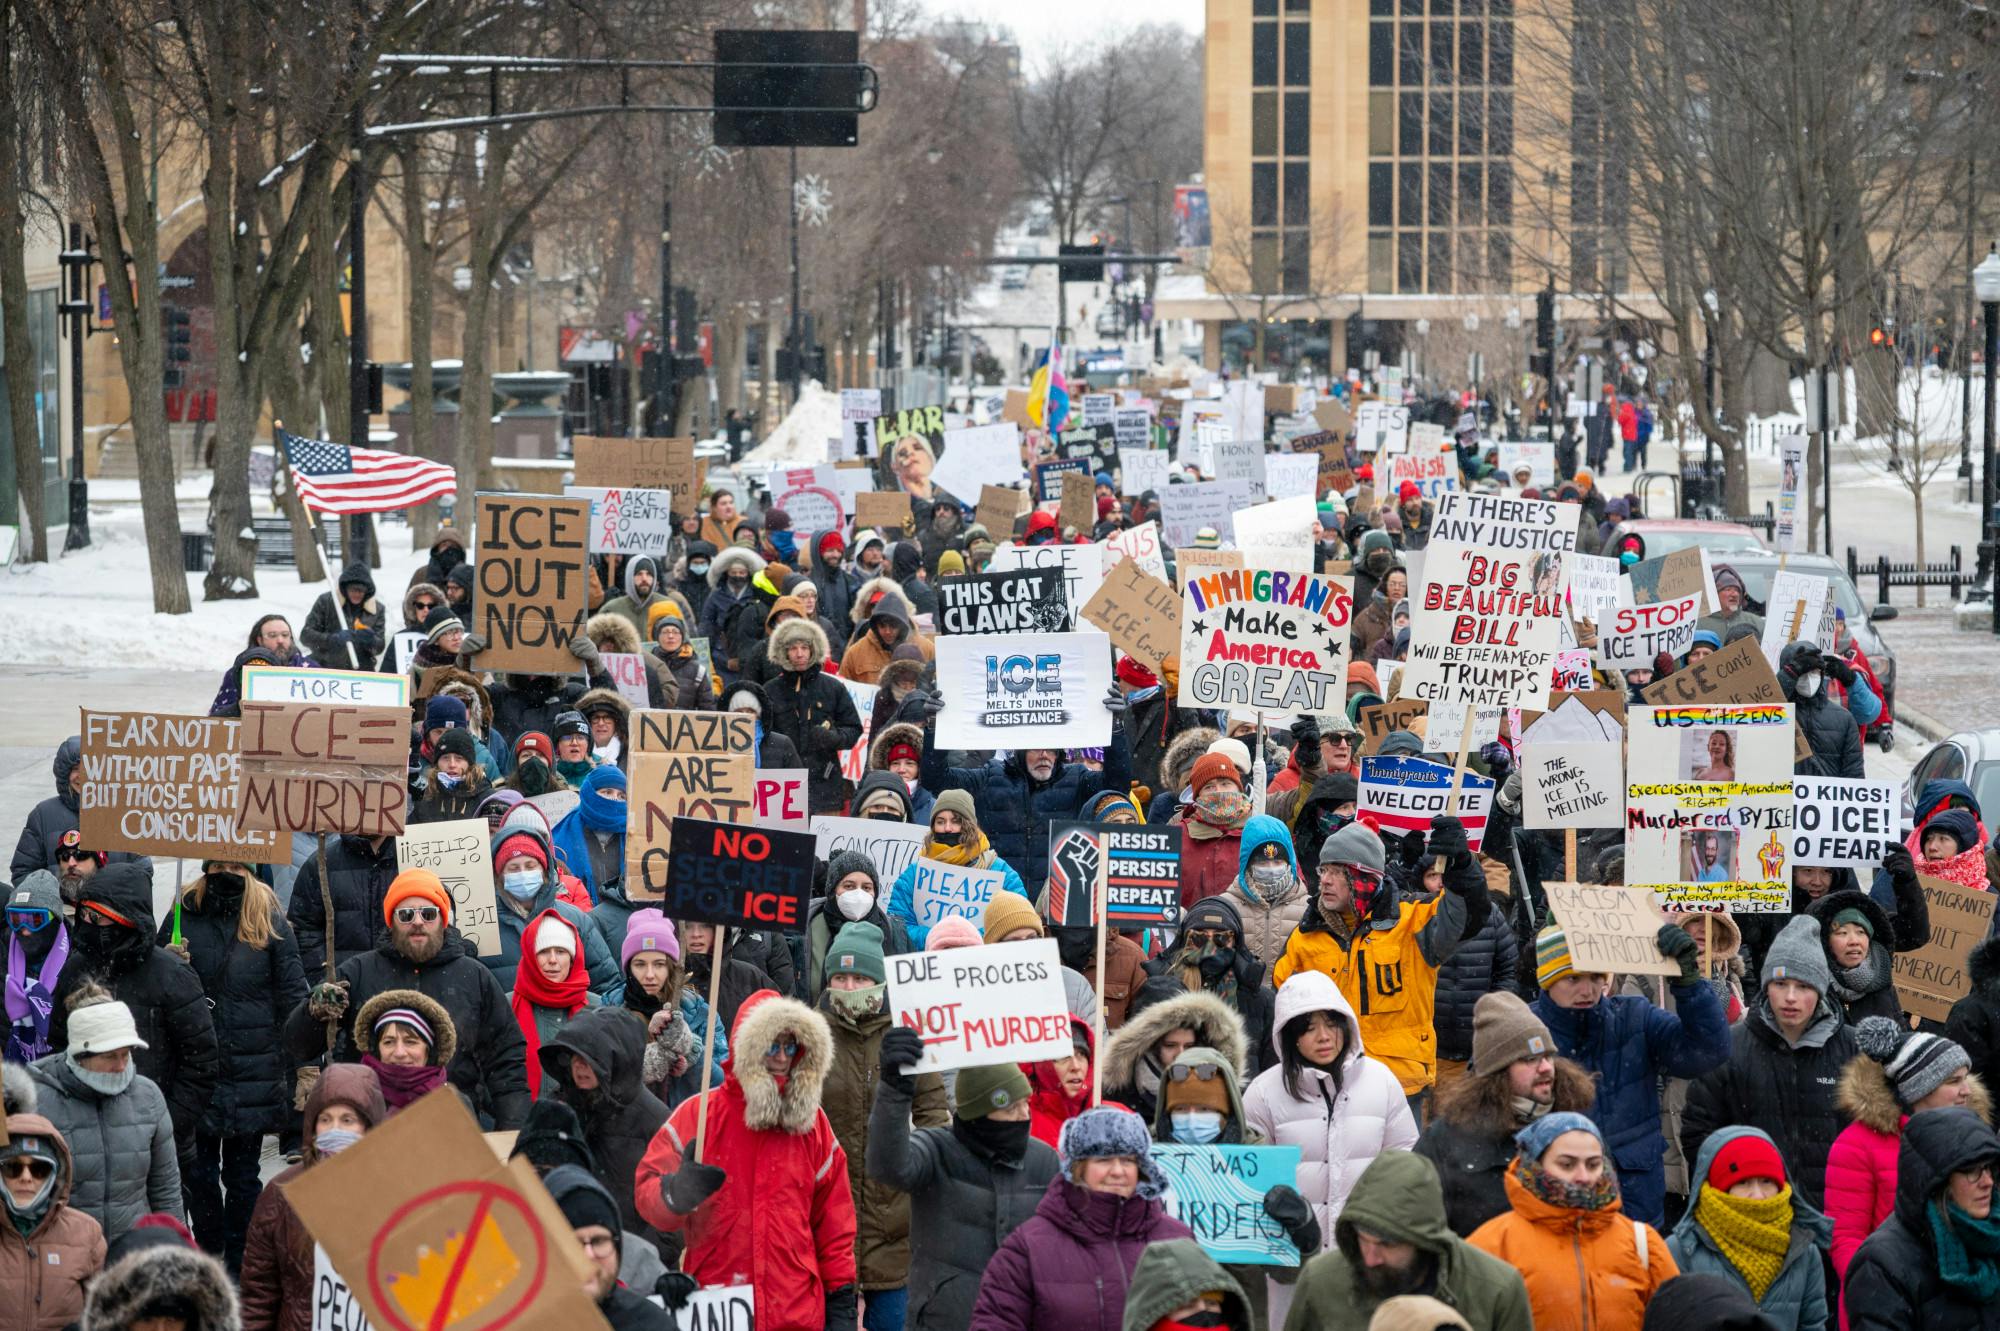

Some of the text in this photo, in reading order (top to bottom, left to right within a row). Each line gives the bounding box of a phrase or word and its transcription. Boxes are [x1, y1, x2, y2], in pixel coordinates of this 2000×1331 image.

[876, 406, 945, 450] LIAR
[635, 440, 686, 465] ICE
[1128, 455, 1166, 471] FUCK
[1221, 446, 1255, 457] HONK
[603, 489, 657, 505] MAKE
[604, 503, 668, 519] AGENTS
[1438, 494, 1557, 526] IF THERE'S
[482, 502, 583, 550] ICE
[603, 517, 631, 532] GO
[1432, 519, 1577, 553] ANY JUSTICE
[1011, 548, 1078, 571] ICE
[1181, 551, 1236, 564] RIGHTS
[479, 558, 581, 600] OUT
[942, 576, 1043, 607] THIS CAT
[1124, 562, 1145, 593] I
[1187, 568, 1354, 628] IMMIGRANTS
[485, 602, 585, 650] NOW
[943, 600, 1036, 633] CLAWS
[1094, 597, 1142, 642] ICE
[1224, 606, 1299, 641] Make
[1615, 599, 1695, 635] STOP
[1206, 628, 1323, 671] America
[1603, 634, 1636, 660] ICE
[1640, 619, 1697, 658] TERROR
[1443, 646, 1464, 661] BE
[1467, 648, 1490, 662] THE
[1529, 652, 1553, 666] OF
[290, 679, 364, 700] MORE
[985, 653, 1062, 698] ICE
[1191, 661, 1338, 711] GREAT
[1650, 664, 1719, 705] ICE
[985, 711, 1063, 726] RESISTANCE
[986, 698, 1063, 710] MELTS UNDER
[1654, 709, 1695, 728] US
[86, 713, 160, 749] FEAR
[163, 717, 219, 748] NOT
[640, 713, 753, 752] NAZIS
[82, 753, 184, 783] WITHOUT
[661, 756, 733, 795] ARE
[1367, 762, 1439, 785] Immigrants
[1538, 766, 1585, 789] WRONG
[1543, 757, 1567, 772] THE
[82, 783, 121, 811] BUT
[124, 783, 193, 810] THOSE
[1366, 789, 1482, 811] WELCOME
[1544, 778, 1590, 804] ICE IS
[1547, 791, 1609, 820] MELTING
[1682, 797, 1728, 809] RIGHT
[1817, 784, 1891, 804] KINGS!
[237, 775, 406, 837] MURDER
[1764, 807, 1792, 830] ICE
[1832, 804, 1891, 835] ICE!
[712, 827, 772, 862] NO
[1108, 832, 1170, 851] RESIST.
[414, 852, 481, 868] OF OUR
[673, 850, 806, 895] SECRET
[1108, 859, 1179, 879] PERSIST.
[917, 867, 997, 903] PLEASE
[1107, 887, 1177, 906] REPEAT.
[1553, 886, 1638, 911] RACISM
[464, 905, 497, 927] ICE
[672, 882, 798, 925] POLICE
[923, 899, 979, 921] STOP
[1561, 909, 1635, 932] IS NOT
[895, 955, 1048, 989] DUE PROCESS
[1891, 954, 1961, 990] AMERICA
[901, 1002, 1073, 1052] NOT MURDER
[1210, 1152, 1258, 1178] WAS
